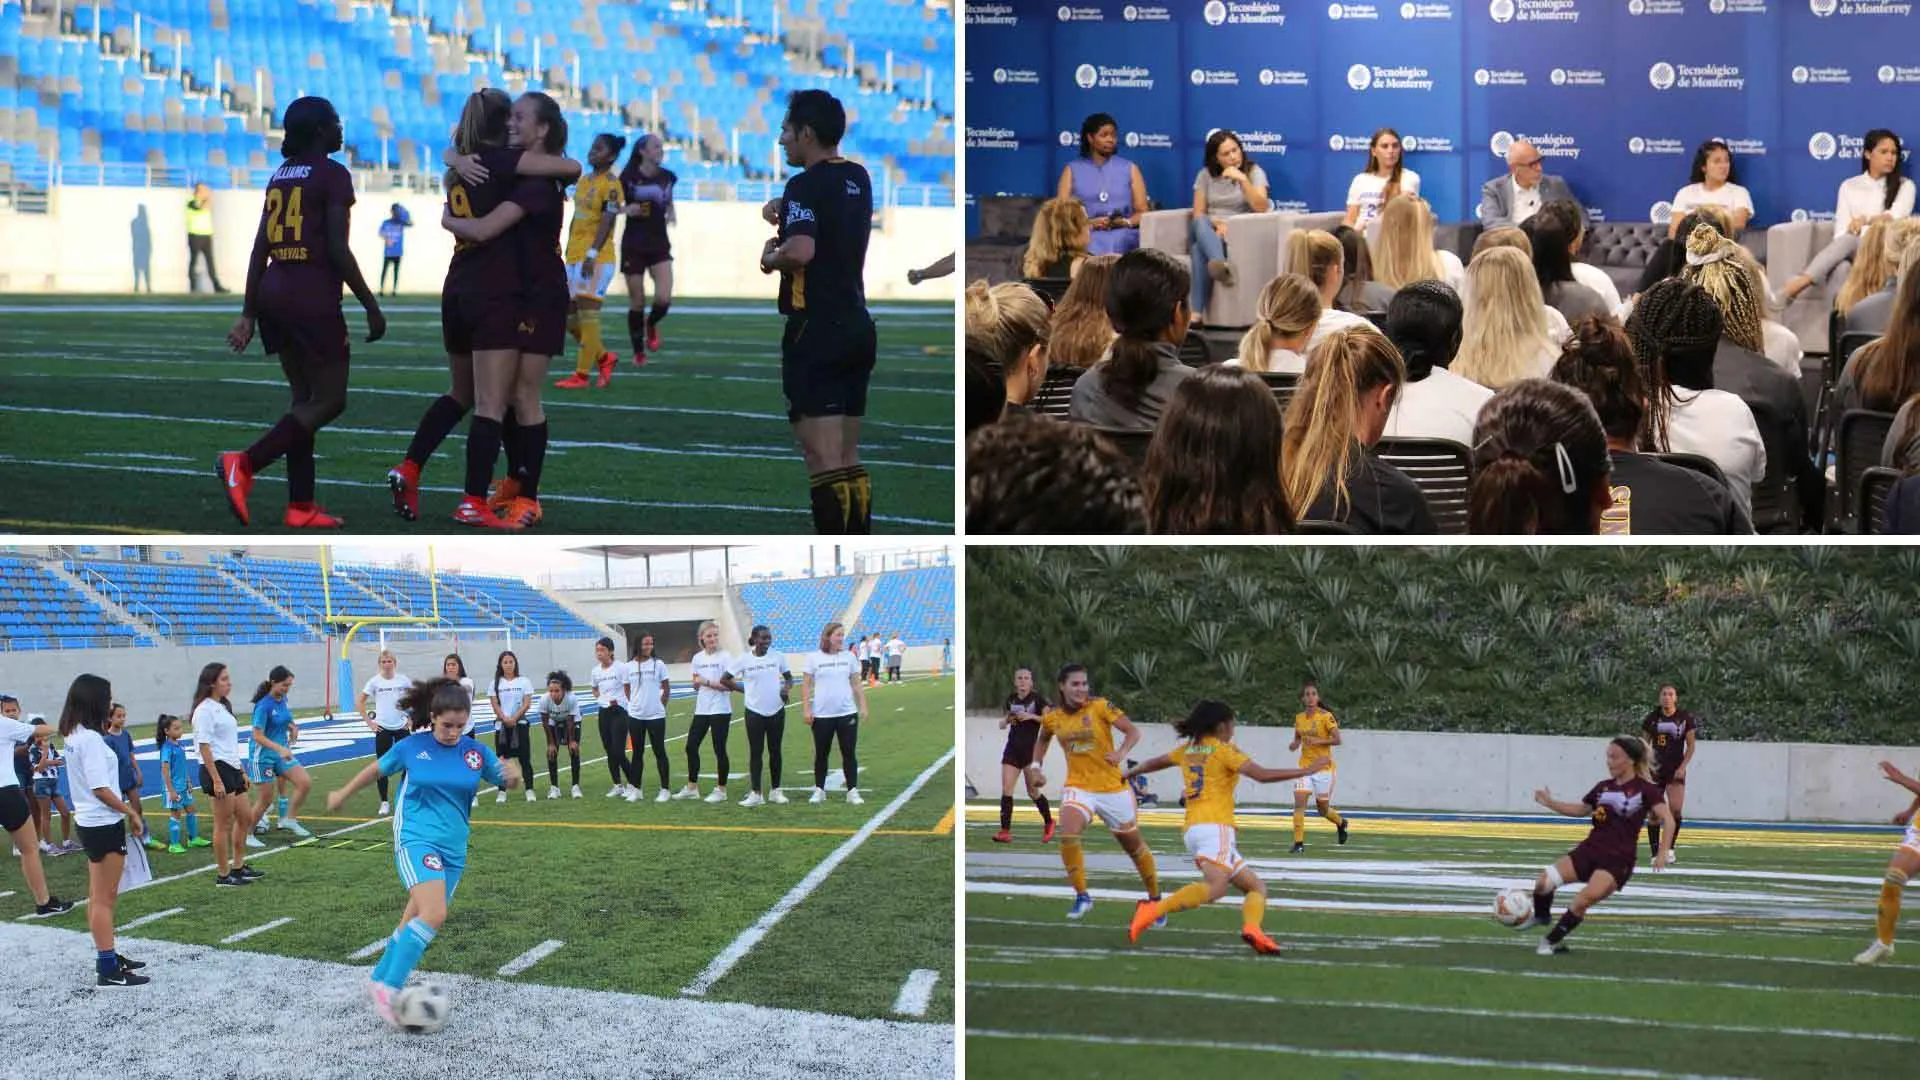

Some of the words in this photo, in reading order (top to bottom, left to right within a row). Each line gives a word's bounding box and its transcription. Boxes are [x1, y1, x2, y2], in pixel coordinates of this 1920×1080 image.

[1516, 9, 1528, 21] de
[1530, 10, 1580, 23] Monterrey
[1840, 3, 1852, 14] de
[1855, 3, 1911, 16] Monterrey
[1372, 66, 1429, 80] Tecnológico
[1677, 64, 1739, 79] Tecnológico
[1373, 78, 1384, 89] de
[1386, 78, 1434, 91] Monterrey
[1677, 76, 1690, 88] de
[1692, 76, 1745, 91] Monterrey
[1233, 131, 1282, 145] ecnológico
[1536, 146, 1580, 160] onterrey
[1839, 148, 1852, 158] de
[451, 184, 474, 218] 9
[267, 186, 303, 242] 24
[1187, 766, 1203, 799] 3
